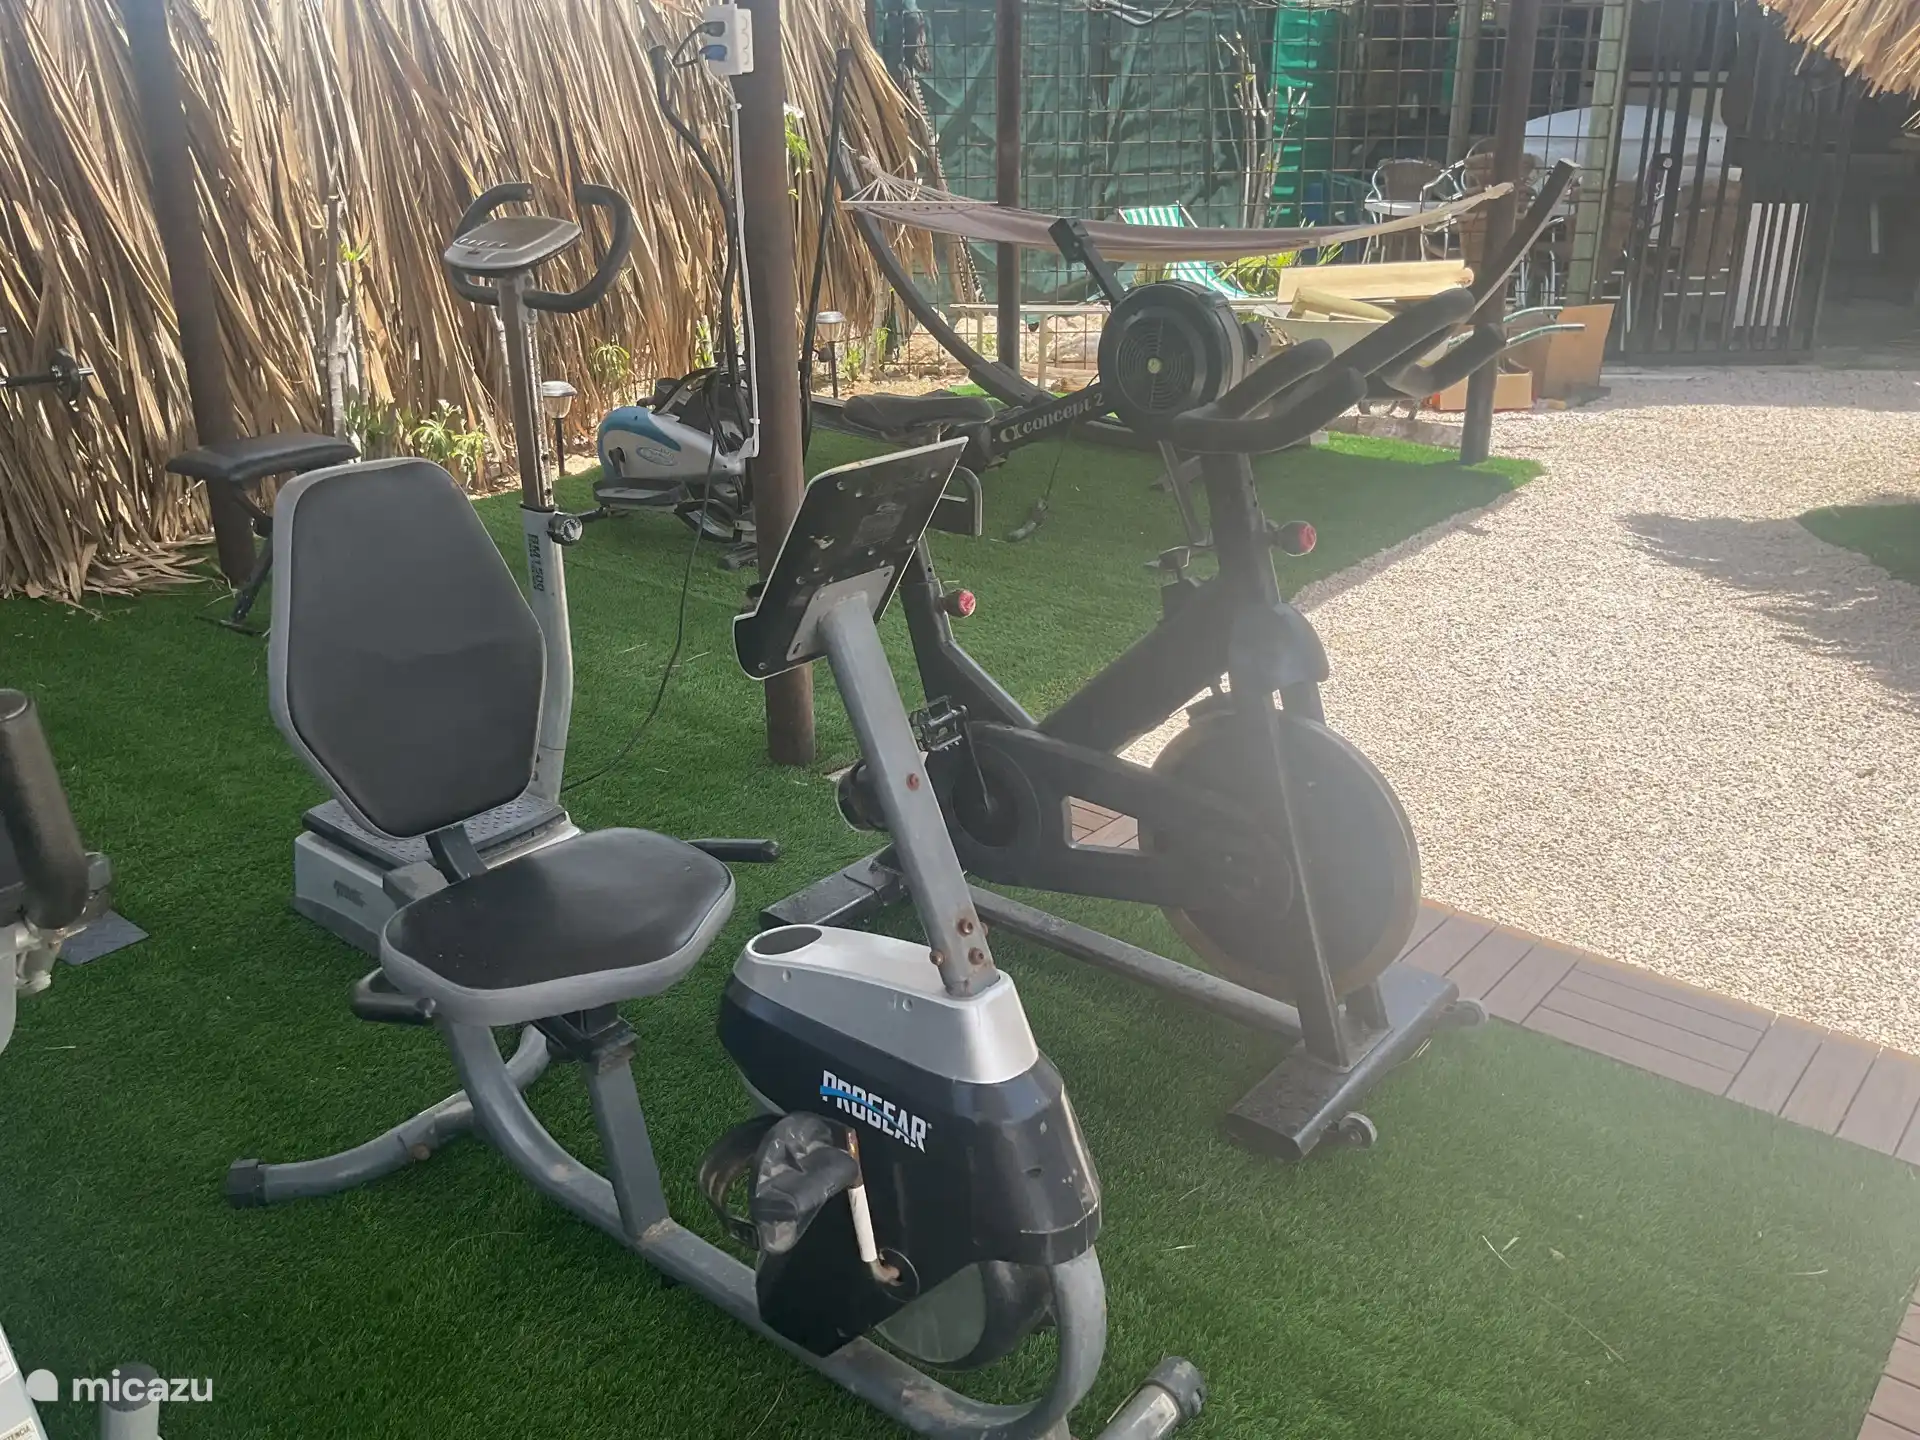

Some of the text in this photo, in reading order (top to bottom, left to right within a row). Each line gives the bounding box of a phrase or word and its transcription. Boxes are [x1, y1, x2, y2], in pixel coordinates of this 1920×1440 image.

[1023, 392, 1104, 434] concept 2
[822, 1069, 929, 1154] PROGEAR
